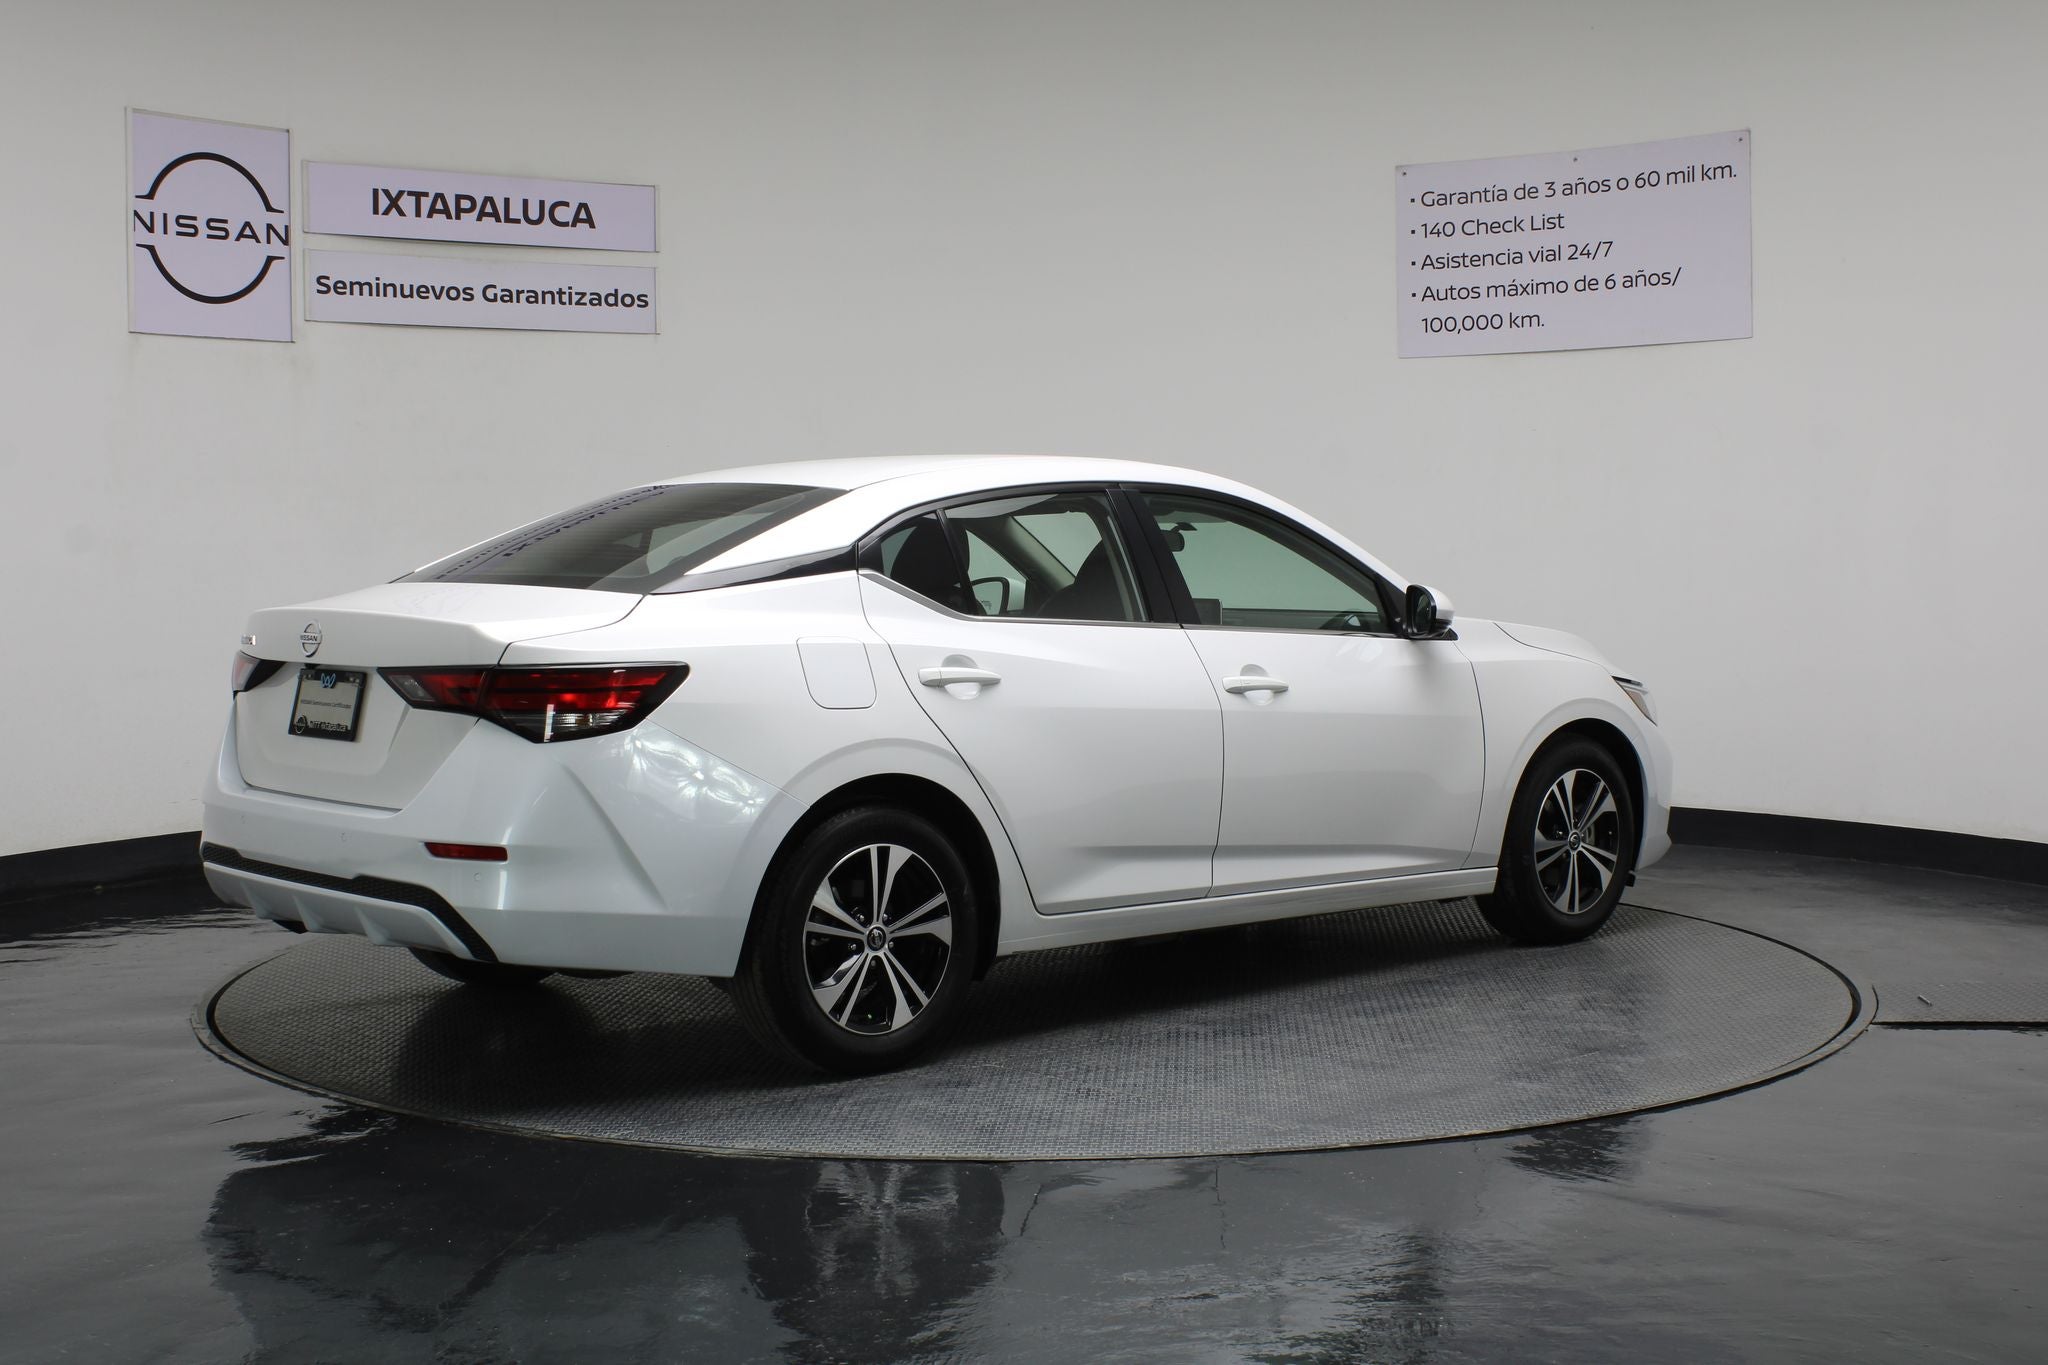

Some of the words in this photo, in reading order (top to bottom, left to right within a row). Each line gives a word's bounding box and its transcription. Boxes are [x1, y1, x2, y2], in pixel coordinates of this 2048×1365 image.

[1420, 184, 1508, 208] Garantía
[1513, 183, 1539, 201] de
[1544, 181, 1557, 198] 3
[1561, 176, 1612, 197] años
[1616, 177, 1630, 191] o
[1634, 170, 1661, 189] 60
[1666, 164, 1695, 186] mil
[1701, 163, 1737, 182] km.
[372, 187, 597, 230] IXTAPALUCA
[1420, 221, 1456, 239] 140
[1461, 215, 1525, 237] Check
[1530, 213, 1565, 232] List
[133, 209, 290, 247] NISSAN
[1420, 248, 1524, 271] Asistencia
[1528, 244, 1562, 264] vial
[1567, 240, 1614, 261] 24/7
[315, 274, 475, 302] Seminuevos
[481, 283, 649, 309] Garantizados
[1421, 284, 1481, 303] Autos
[1486, 278, 1569, 299] máximo
[1573, 274, 1599, 293] de
[1604, 273, 1617, 290] 6
[1622, 266, 1682, 289] años/
[1421, 313, 1504, 335] 100,000
[1509, 311, 1545, 329] km.
